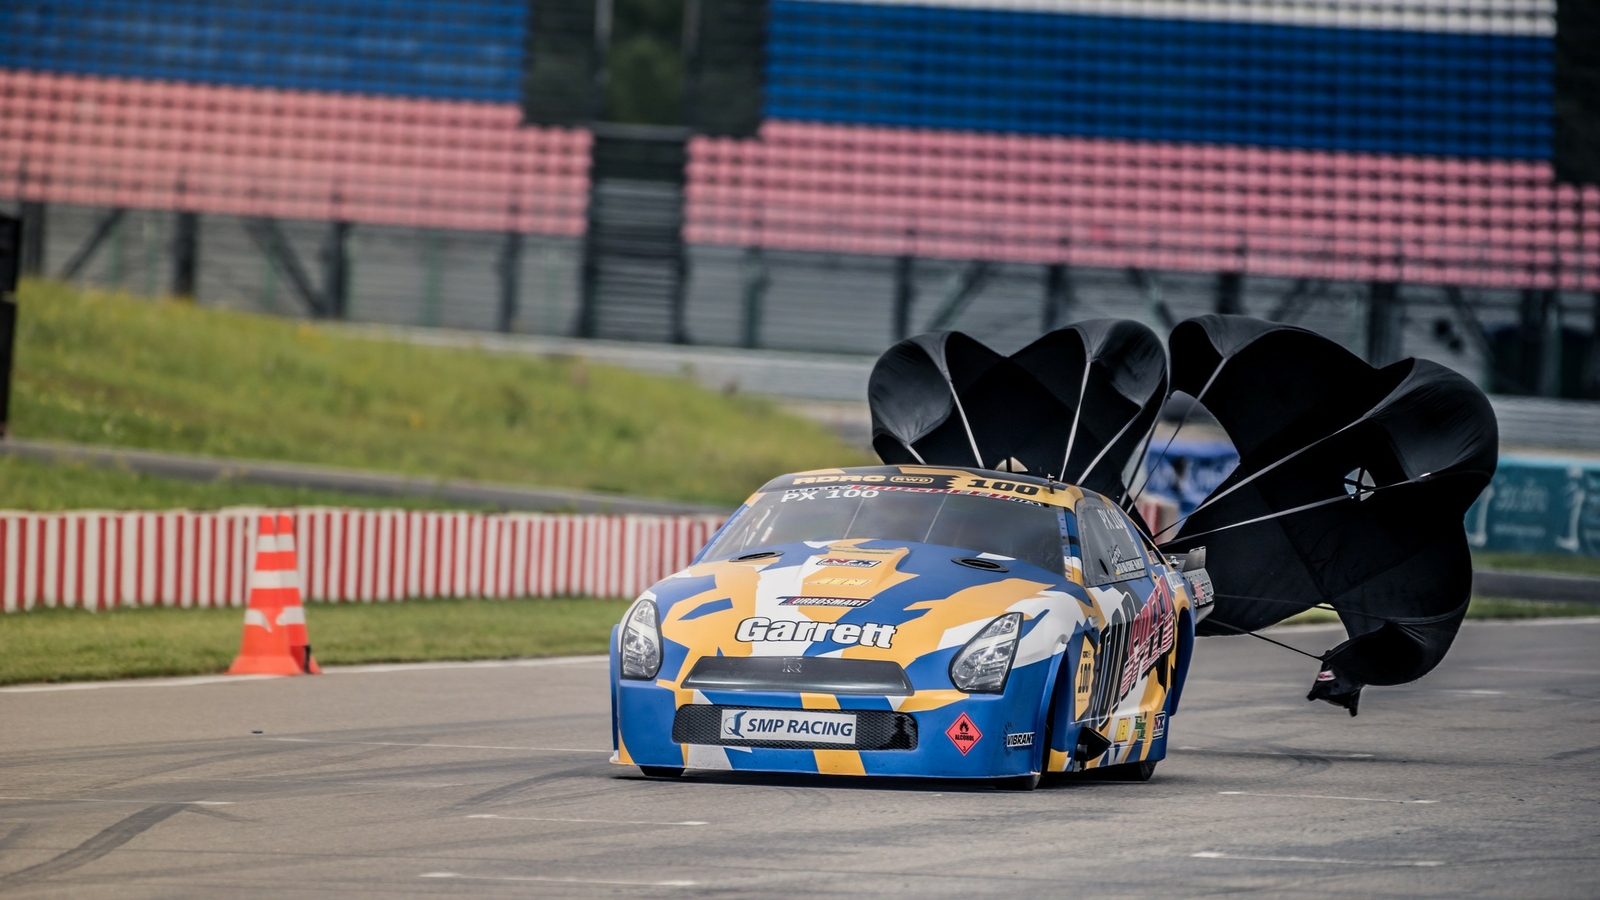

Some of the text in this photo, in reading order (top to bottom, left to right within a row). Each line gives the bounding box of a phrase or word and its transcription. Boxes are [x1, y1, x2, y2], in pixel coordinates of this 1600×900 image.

[967, 479, 1039, 495] 100
[781, 490, 879, 503] PX 100
[776, 596, 871, 607] TURBOSMART
[735, 617, 898, 649] Garrett
[1078, 662, 1091, 694] 100
[747, 718, 854, 737] SMP RACING
[954, 734, 975, 742] ALCOHOL
[1007, 732, 1035, 747] VIBRANT
